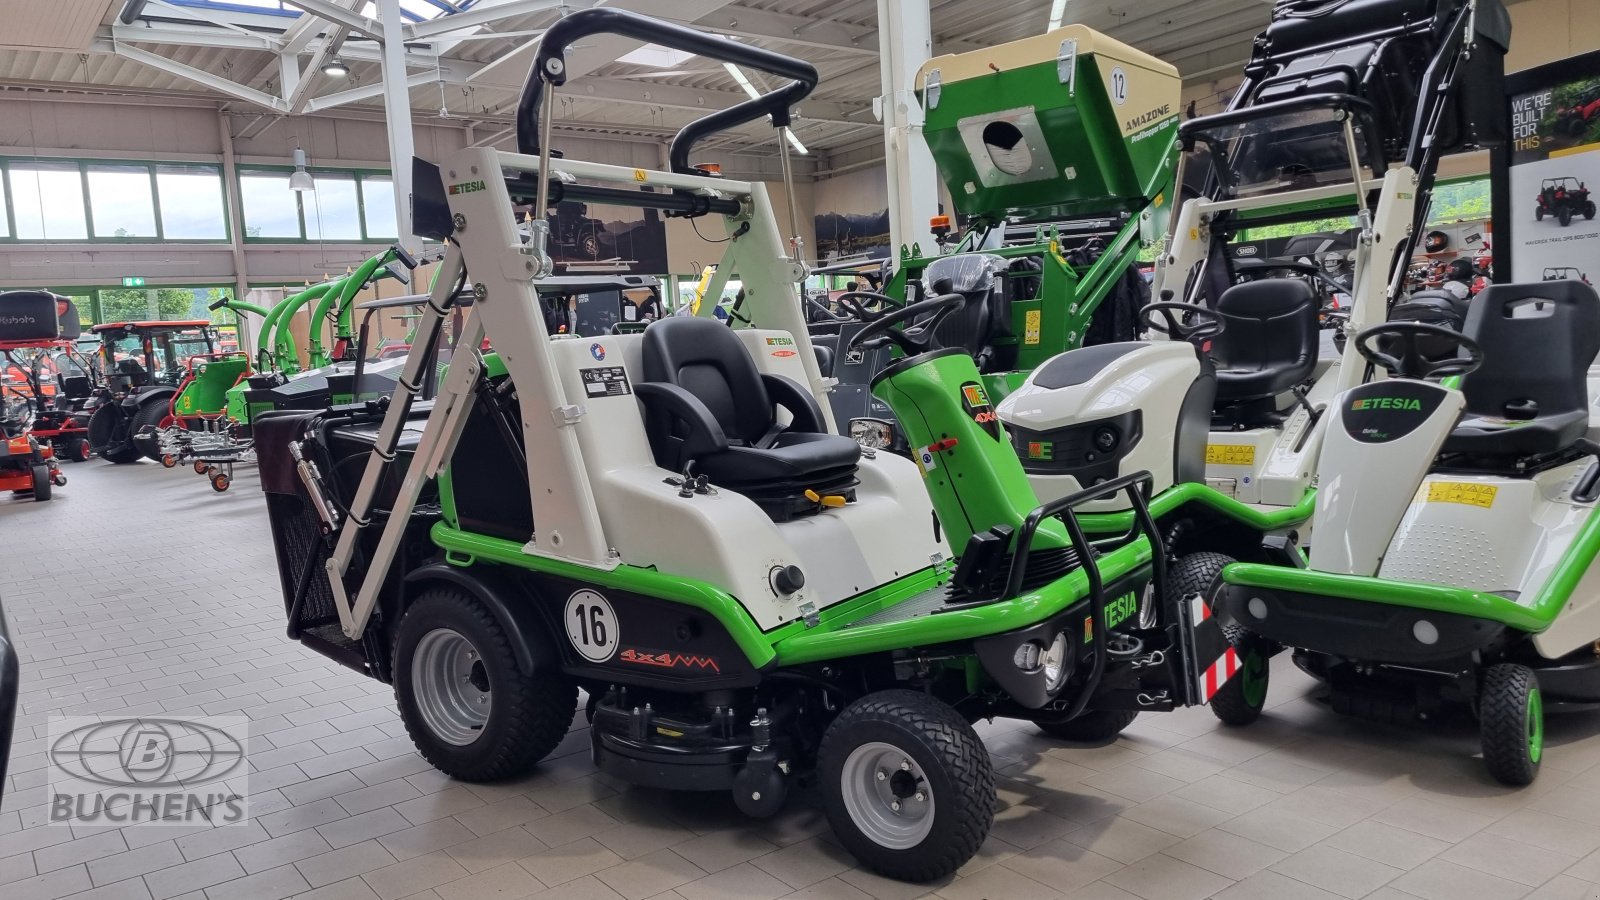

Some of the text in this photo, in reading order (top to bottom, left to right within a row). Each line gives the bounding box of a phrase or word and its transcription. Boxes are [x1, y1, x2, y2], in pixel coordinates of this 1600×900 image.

[1113, 73, 1125, 99] 12
[1512, 92, 1552, 113] WE'RE
[1125, 103, 1170, 132] AMAZONE
[1512, 106, 1546, 126] BUILT
[1513, 122, 1537, 140] FOR
[1513, 135, 1540, 152] THIS
[449, 180, 486, 195] ETESIA
[766, 337, 794, 346] ETESIA
[1352, 397, 1422, 411] ETESIA
[1104, 591, 1137, 631] TESIA
[575, 604, 607, 647] 16
